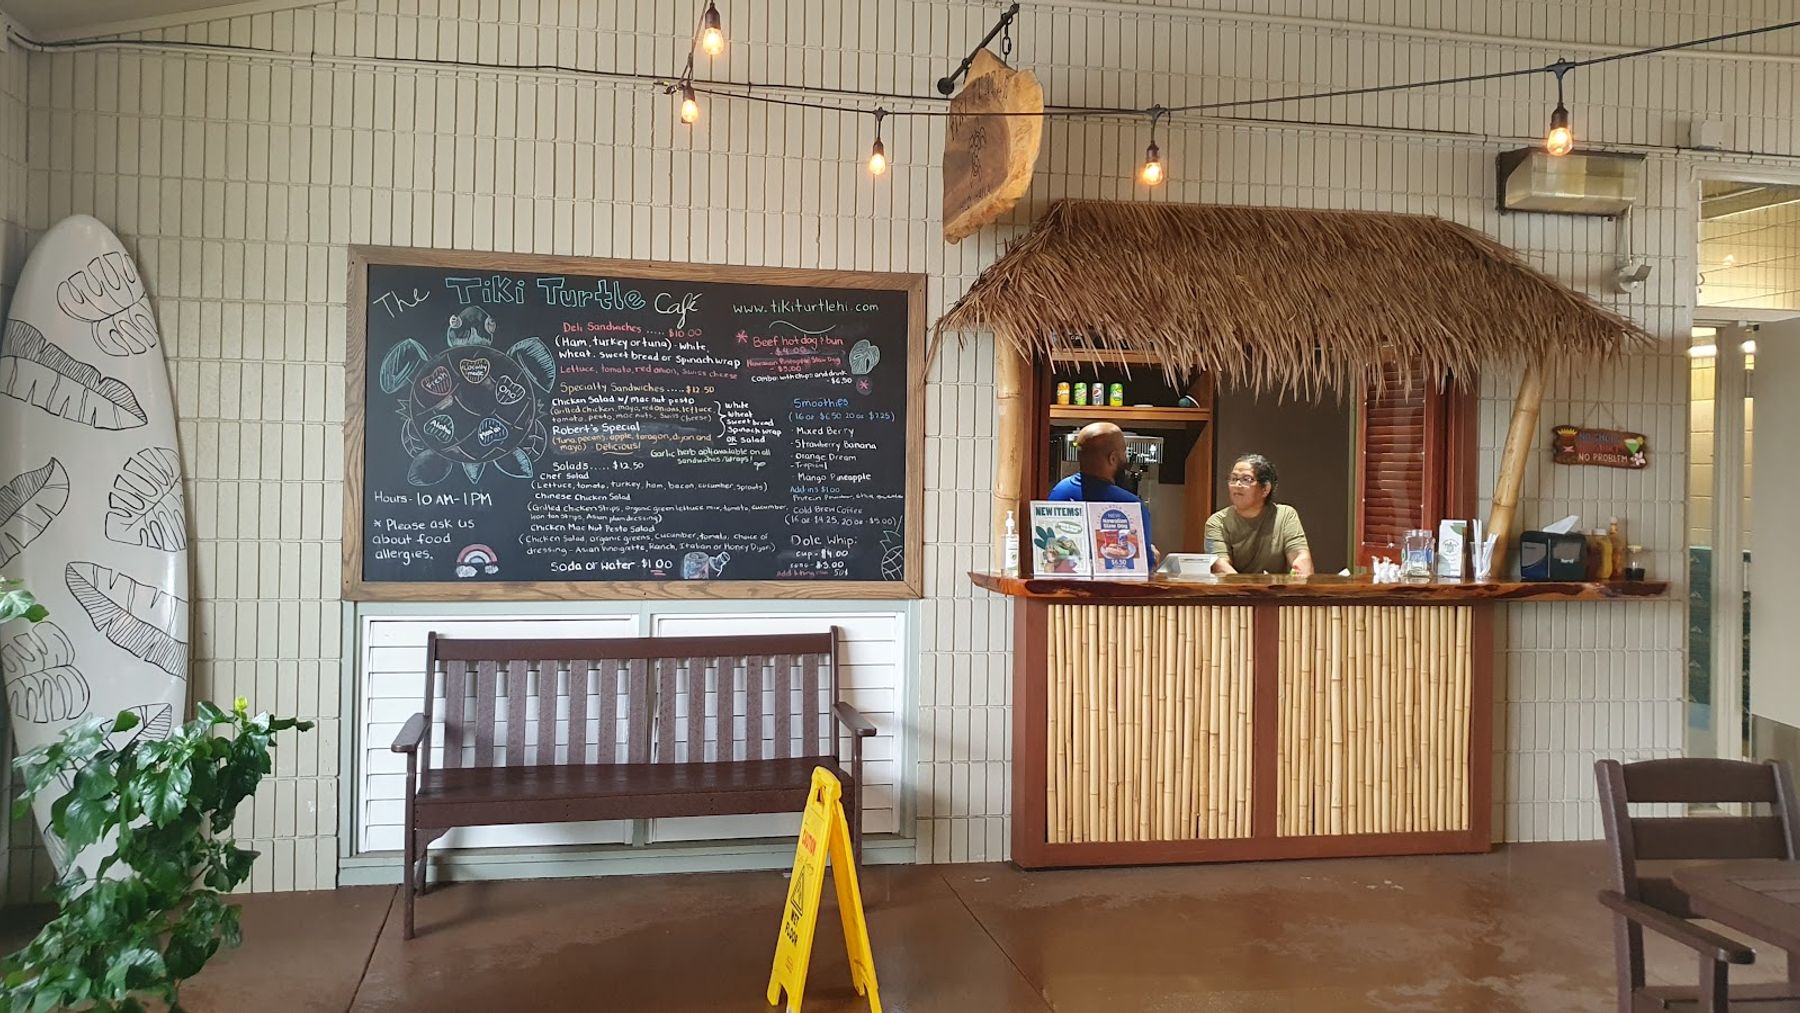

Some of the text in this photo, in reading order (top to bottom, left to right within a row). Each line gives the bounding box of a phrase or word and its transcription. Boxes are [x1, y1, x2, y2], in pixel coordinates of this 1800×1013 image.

[373, 288, 431, 318] The
[537, 277, 646, 310] Turtle
[654, 292, 703, 329] Café
[563, 322, 583, 333] Deli
[587, 321, 642, 333] Sandwiches
[593, 336, 628, 350] turkey
[753, 334, 844, 350] Beef hot dog bun
[631, 350, 659, 361] bread
[715, 358, 741, 370] wrap
[499, 384, 517, 399] Ono
[560, 382, 607, 395] Specialty
[610, 382, 665, 392] Sandwiches
[552, 397, 587, 406] Chicken
[617, 395, 629, 404] w/
[651, 395, 666, 403] nut
[668, 396, 695, 406] pesto
[794, 398, 848, 409] Smoothies
[552, 421, 640, 435] Robert's Special
[762, 428, 782, 437] wrap
[796, 426, 855, 437] Mixed Berry
[795, 438, 877, 451] Strawberry Banana
[650, 448, 676, 458] Garlic
[677, 447, 696, 456] herb
[795, 452, 857, 462] Orange Dream
[1578, 453, 1628, 463] NO PROBLEM
[798, 473, 827, 484] Mango
[417, 492, 433, 506] 10
[814, 505, 835, 513] Brew
[1035, 507, 1082, 517] NEW ITEMS!
[386, 518, 475, 532] Please ask us
[568, 523, 586, 531] Mac
[372, 533, 451, 545] about food
[791, 534, 822, 546] Dole
[724, 543, 750, 552] Honey
[375, 549, 433, 565] allergies.
[551, 560, 582, 571] Soda
[585, 561, 598, 570] or
